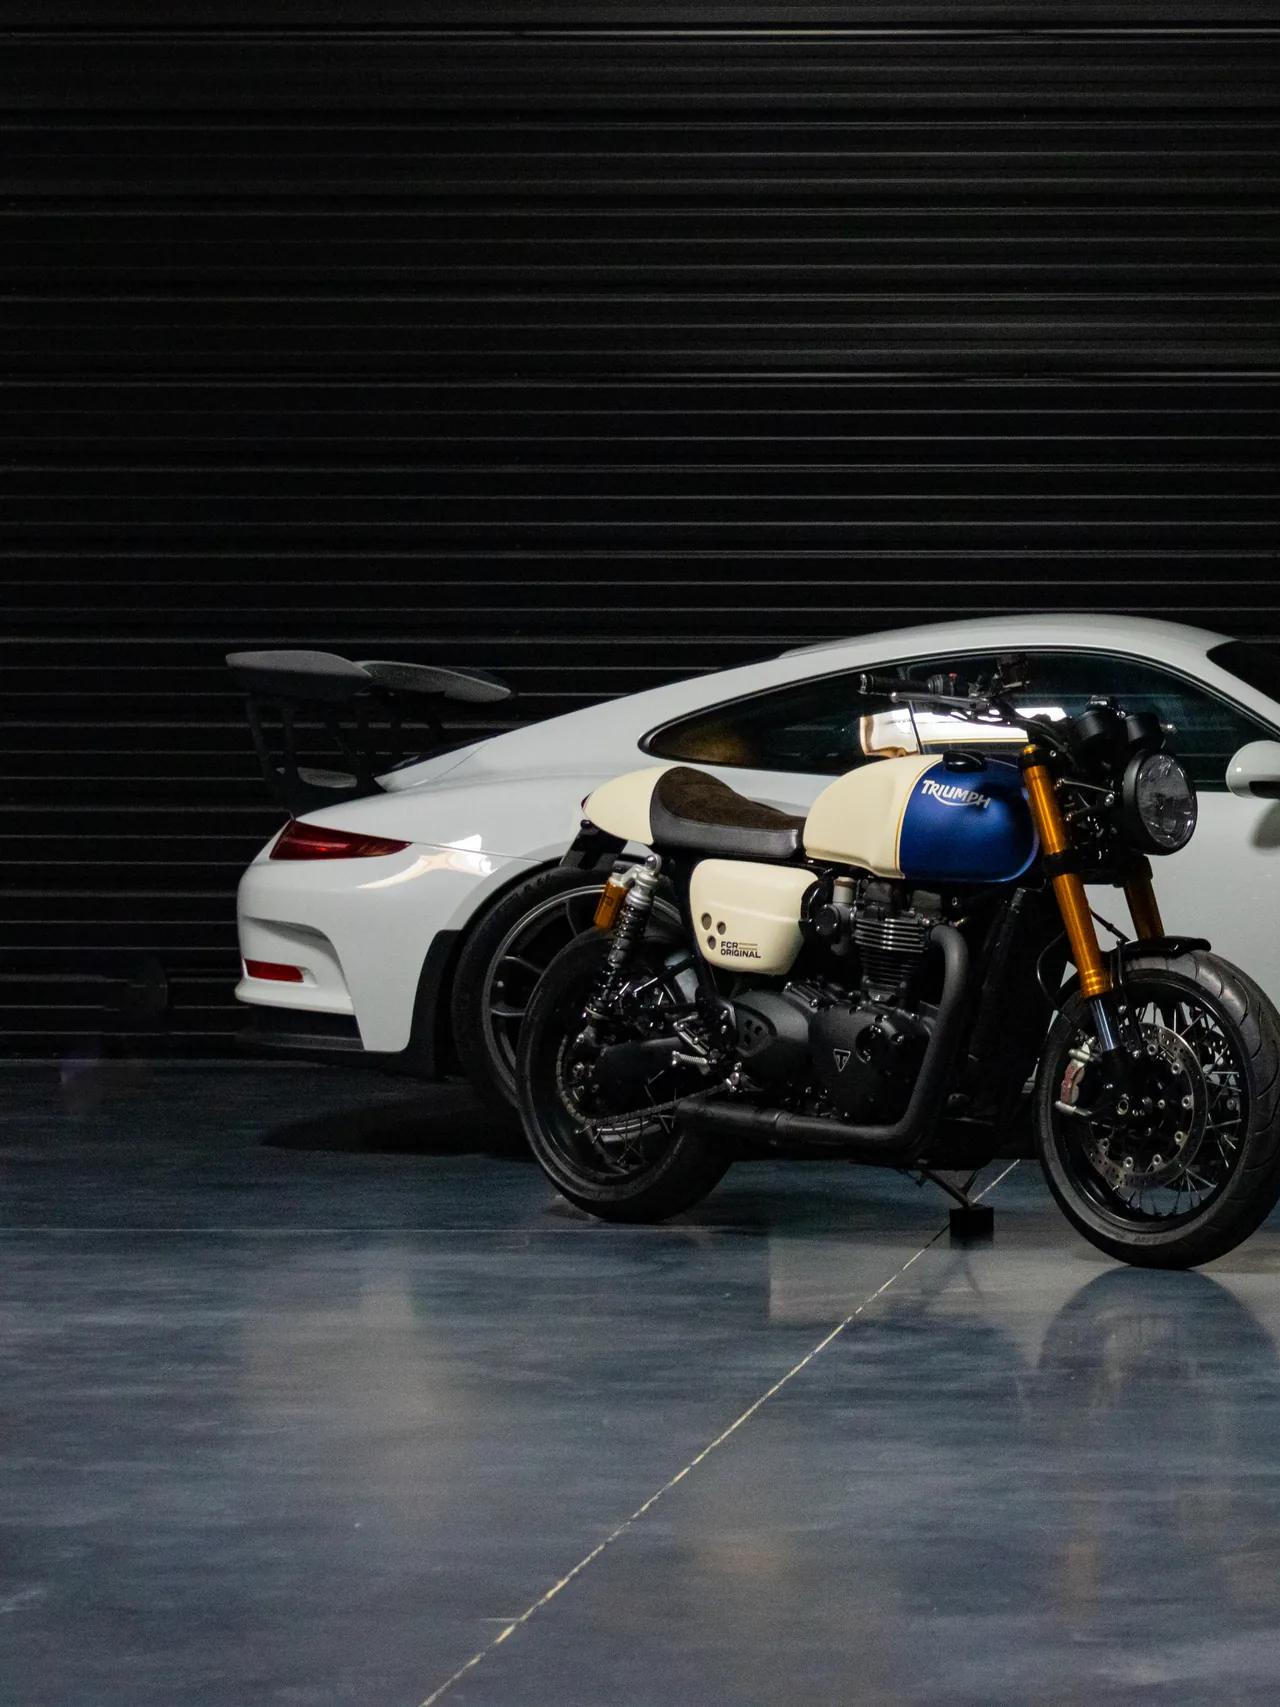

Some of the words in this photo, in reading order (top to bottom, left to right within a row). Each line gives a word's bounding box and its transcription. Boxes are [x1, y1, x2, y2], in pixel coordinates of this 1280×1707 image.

[921, 779, 992, 809] TRIUMPH
[720, 940, 739, 949] FCR
[720, 948, 762, 959] ORIGINAL
